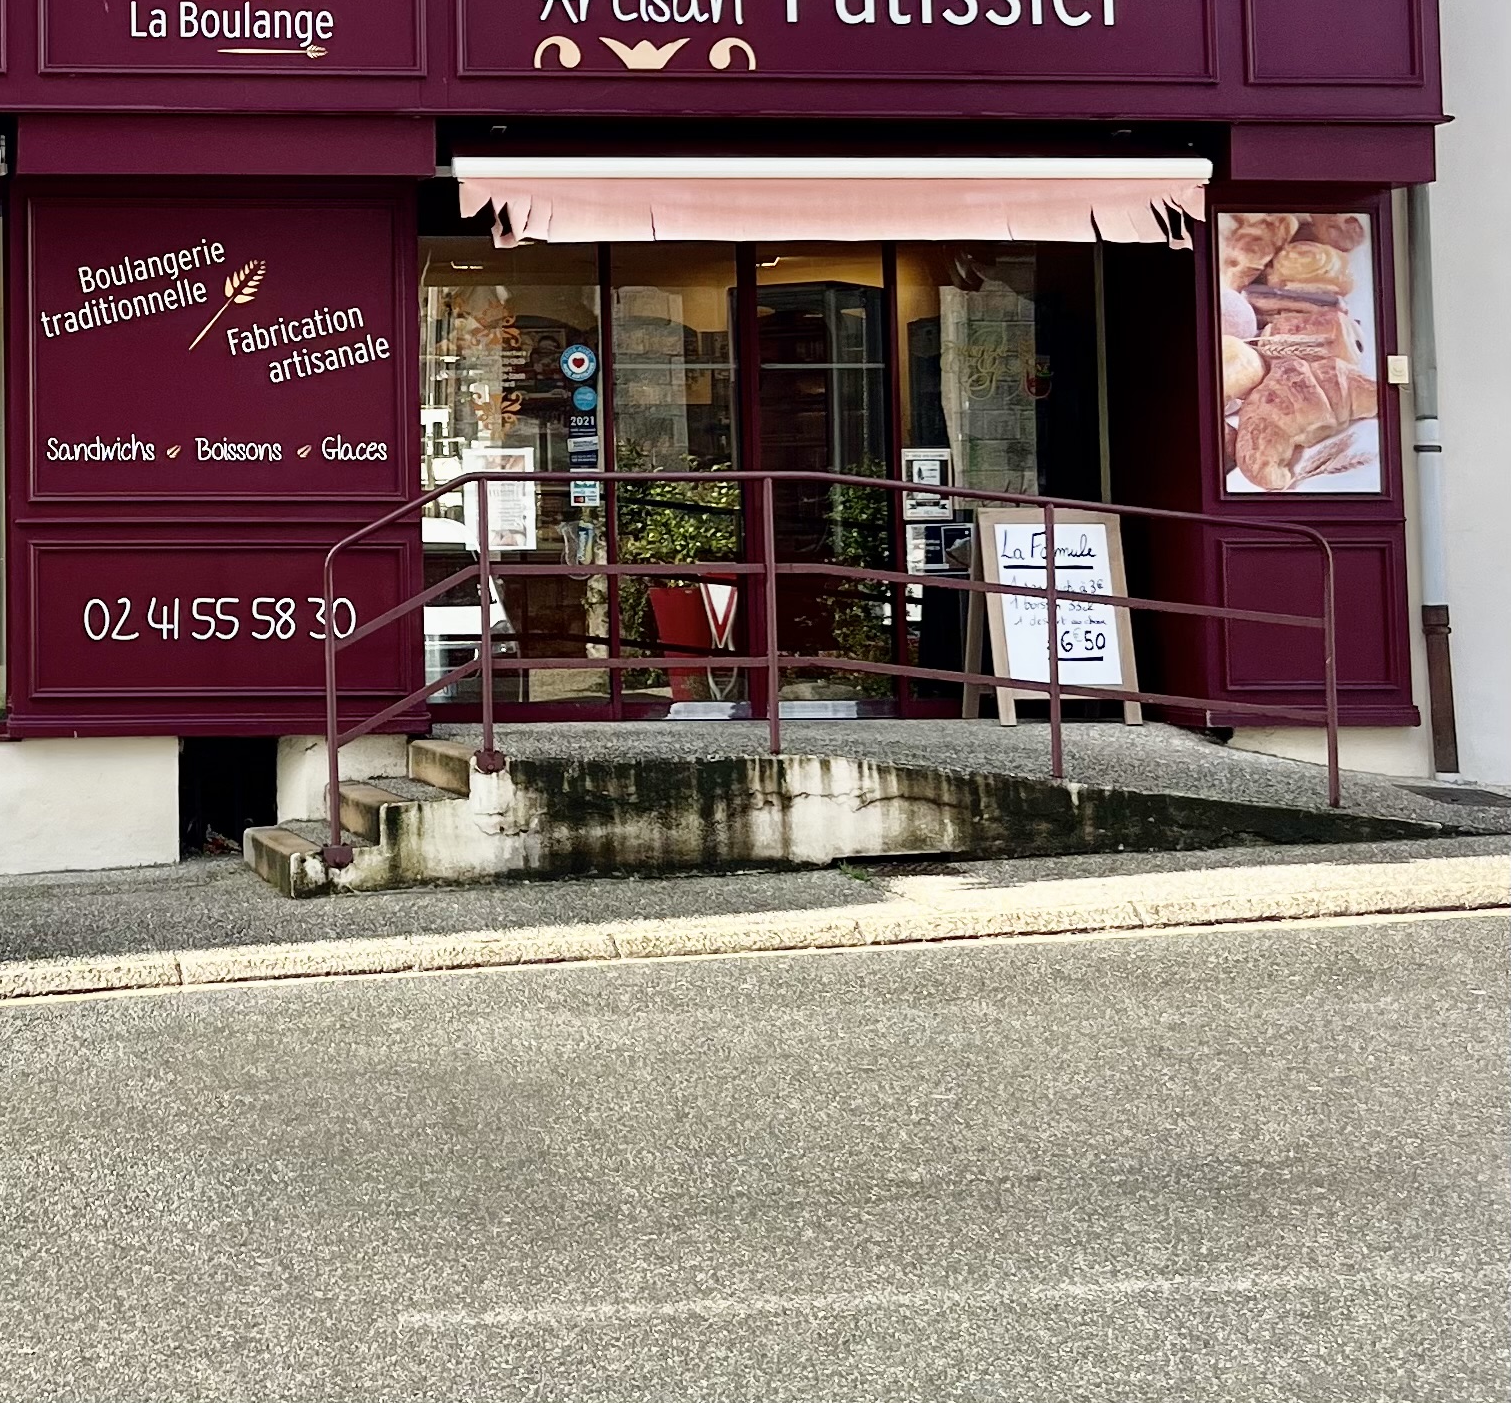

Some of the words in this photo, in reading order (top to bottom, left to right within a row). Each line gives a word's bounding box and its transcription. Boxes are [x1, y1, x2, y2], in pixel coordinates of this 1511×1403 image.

[130, 0, 167, 38] La
[179, 1, 334, 48] Boulange
[78, 238, 226, 294] Boulangerie
[40, 279, 208, 339] traditionnelle
[226, 306, 365, 356] Fabrication
[268, 334, 391, 384] artisanale
[570, 416, 596, 426] 2021
[46, 433, 156, 462] Sandwichs
[194, 436, 283, 462] Boissons
[321, 434, 388, 461] Glaces
[83, 597, 140, 641] 02
[147, 597, 180, 640] 41
[191, 597, 240, 640] 55
[251, 597, 296, 640] 58
[307, 597, 357, 639] 30
